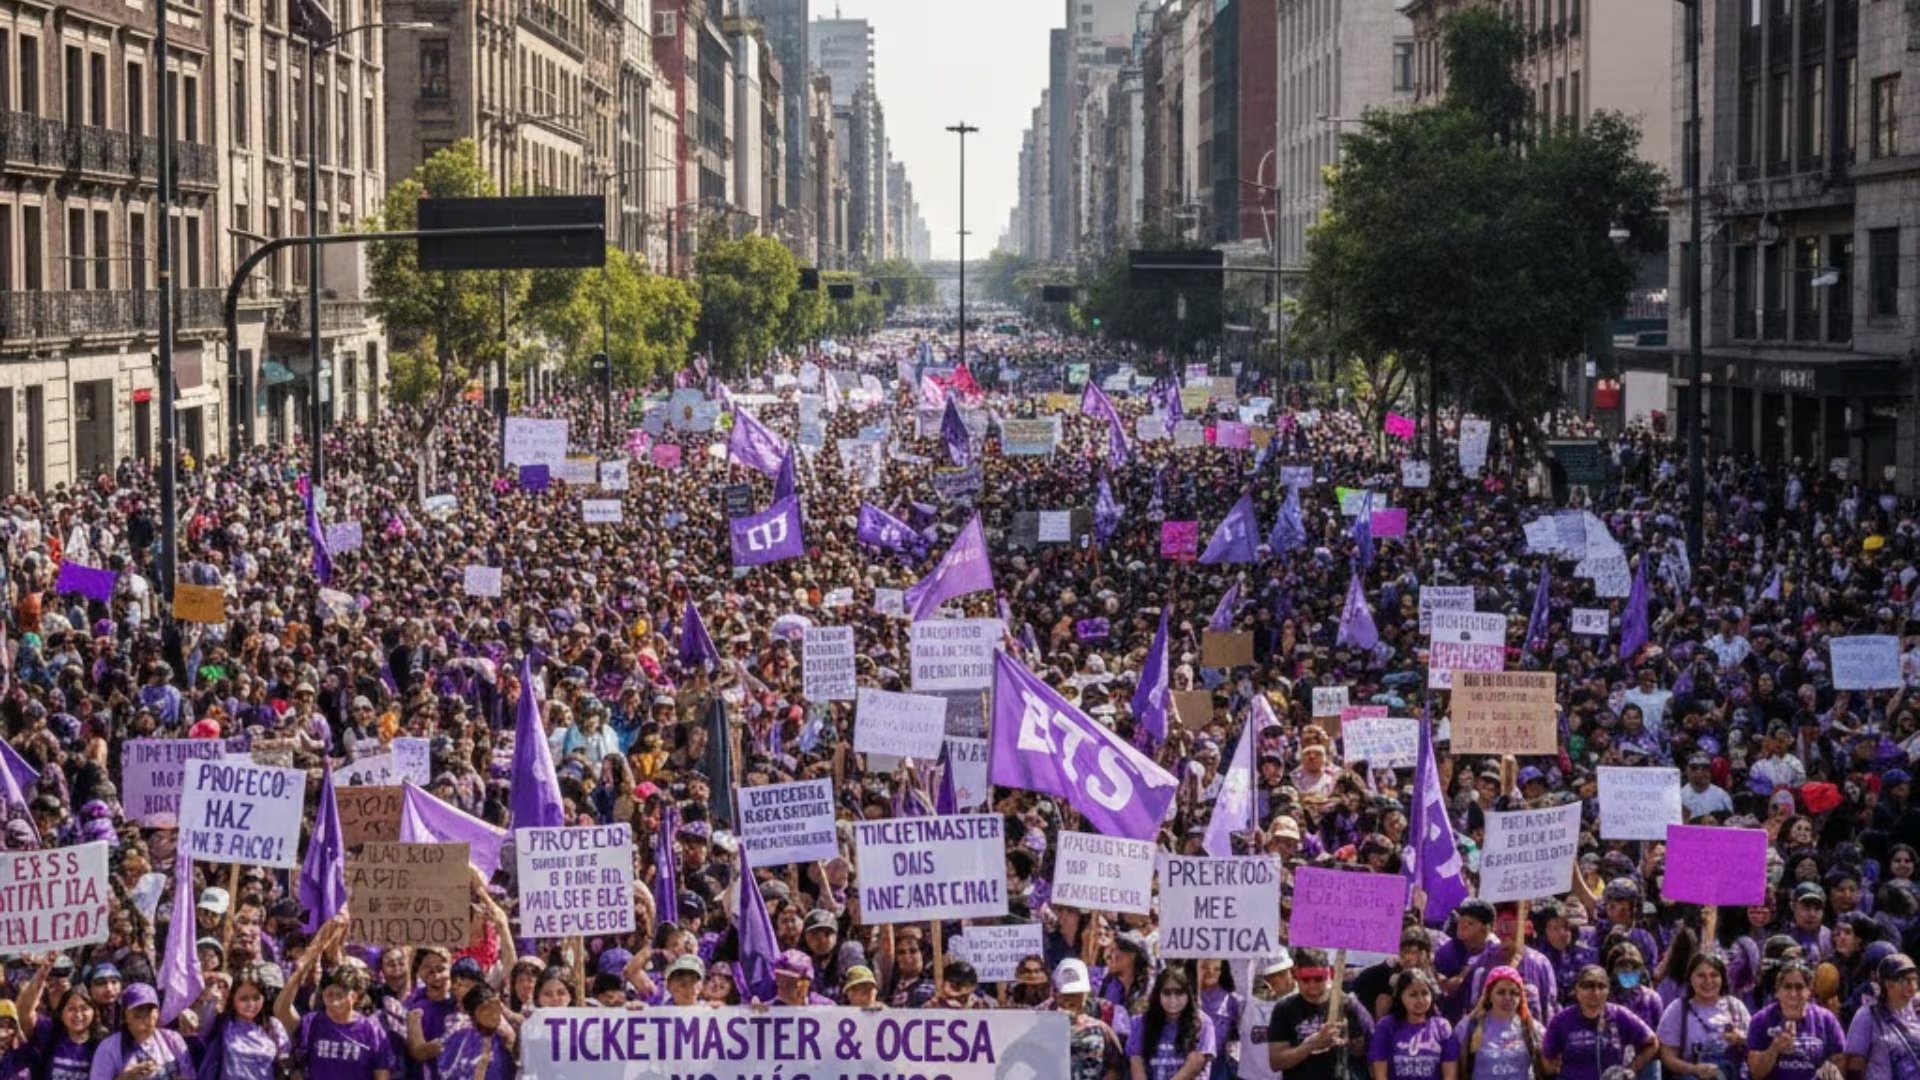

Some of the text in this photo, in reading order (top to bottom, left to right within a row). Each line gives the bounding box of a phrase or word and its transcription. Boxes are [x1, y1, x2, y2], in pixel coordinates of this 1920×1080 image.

[1017, 690, 1134, 811] BTS
[204, 799, 254, 831] HAZ
[1166, 927, 1271, 953] AUSTICA
[544, 1016, 996, 1064] TICKETMASTER & OCESA
